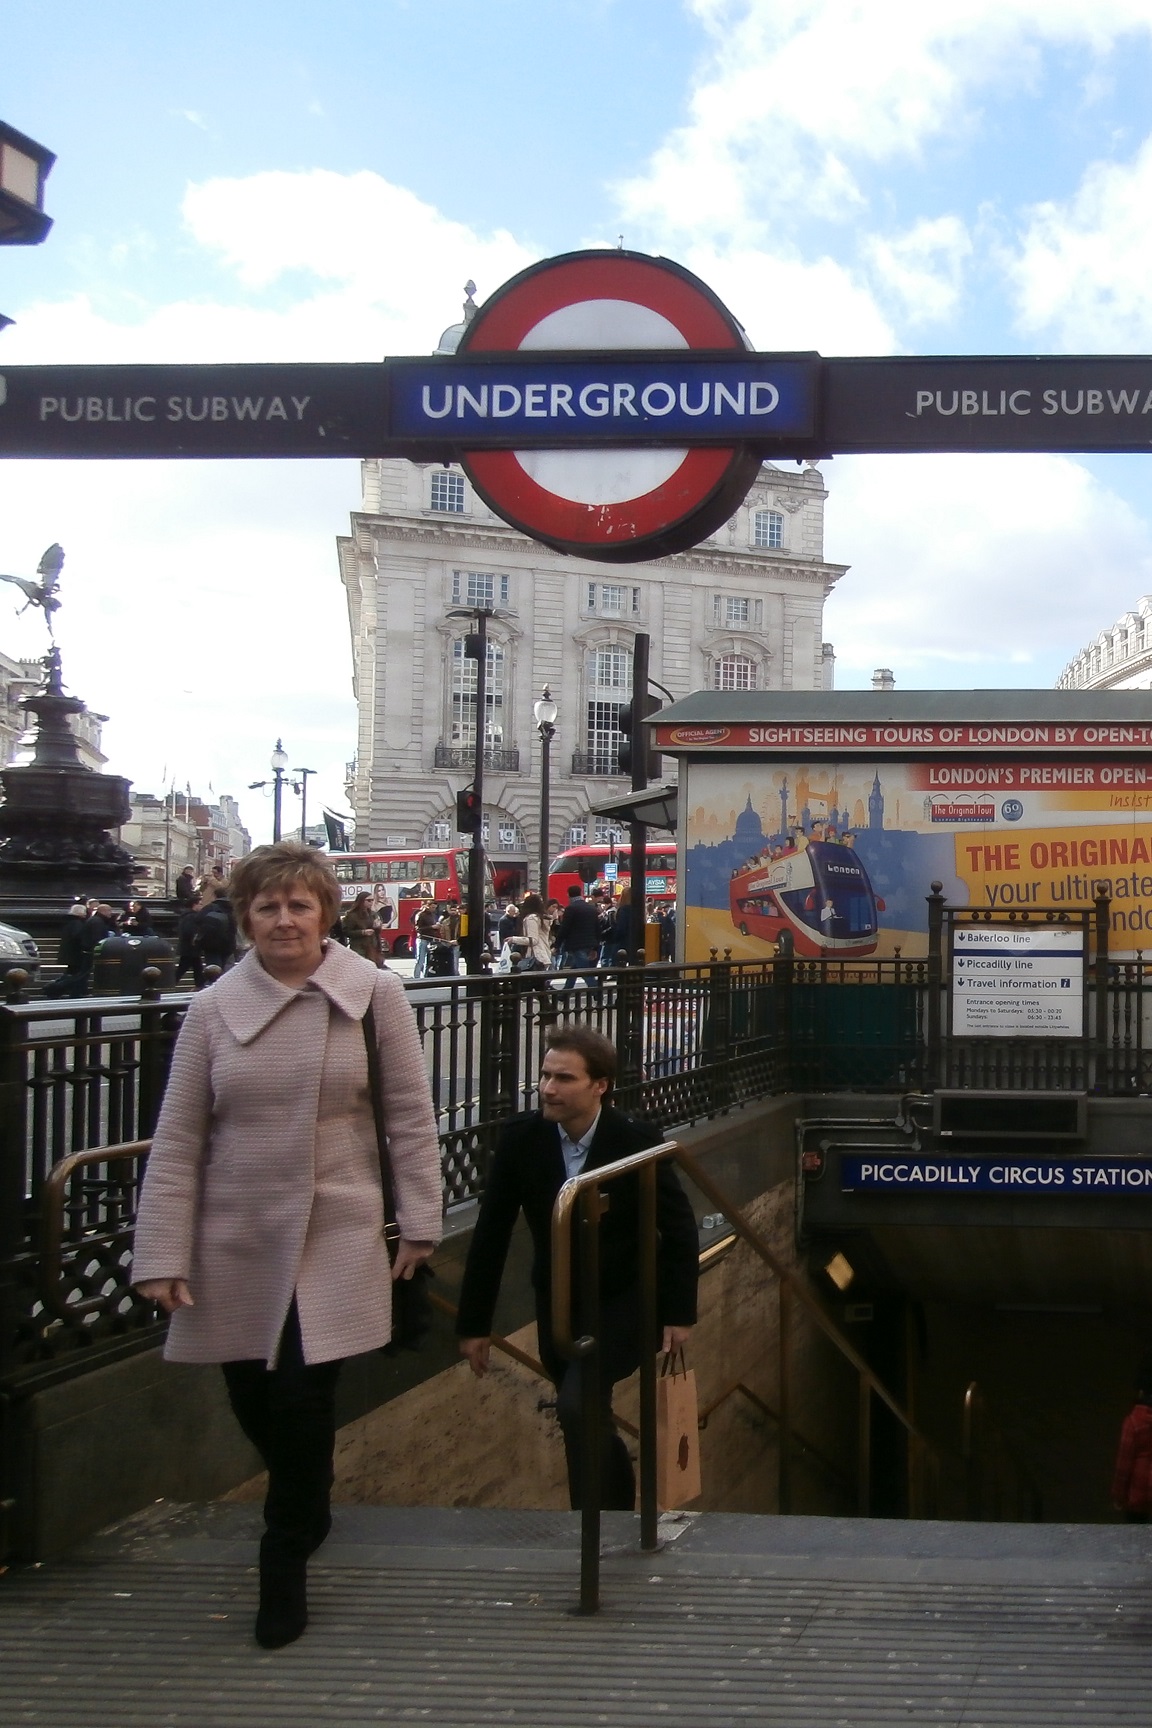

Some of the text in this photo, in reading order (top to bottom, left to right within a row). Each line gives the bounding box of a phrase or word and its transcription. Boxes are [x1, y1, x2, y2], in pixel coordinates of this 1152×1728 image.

[422, 382, 780, 419] UNDERGROUND
[915, 390, 1031, 416] PUBLIC
[39, 396, 311, 422] PUBLIC SUBWAY
[677, 730, 704, 738] OFFICIAL
[749, 727, 867, 743] SIGHTSEEING
[872, 728, 934, 743] TOURS
[939, 728, 963, 742] OF
[968, 728, 1049, 743] LONDON
[1055, 728, 1078, 742] BY
[929, 767, 1014, 784] LONDON'S
[1020, 768, 1095, 784] PREMIER
[1109, 793, 1152, 808] Insist
[934, 803, 992, 817] The Original Tour
[966, 843, 1021, 872] THE
[985, 881, 1041, 907] your
[967, 933, 1031, 943] Bakerloo line
[967, 959, 1033, 971] Piccadilly line
[967, 978, 1058, 989] Travel information
[995, 999, 1020, 1007] opening
[861, 1164, 981, 1183] PICCADILLY
[988, 1166, 1065, 1185] CIRCUS
